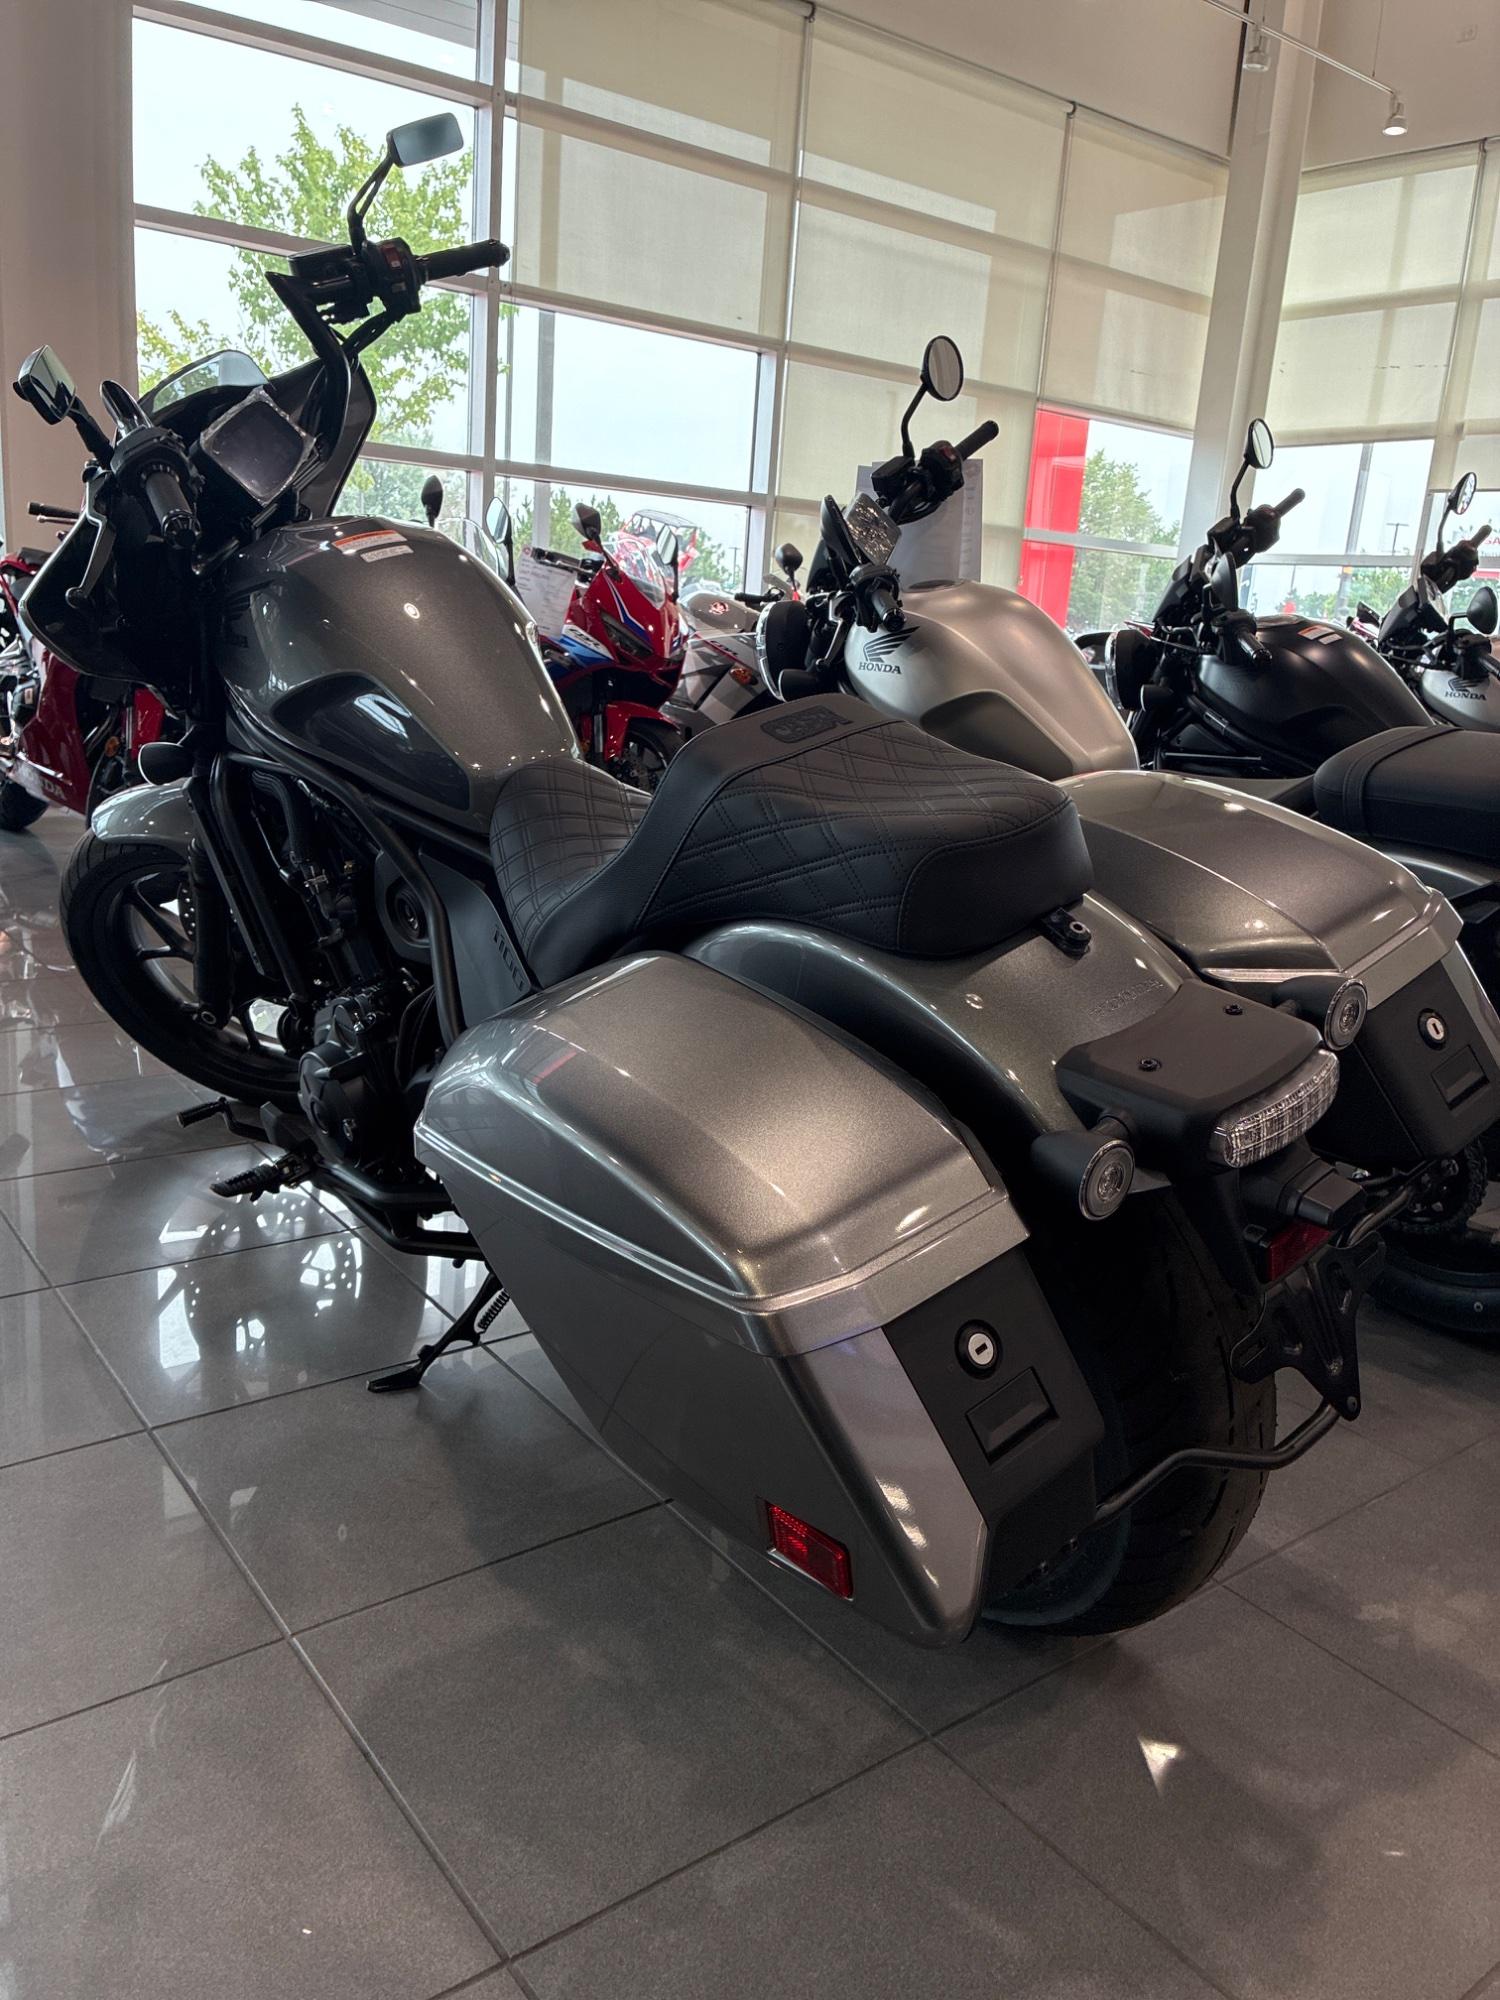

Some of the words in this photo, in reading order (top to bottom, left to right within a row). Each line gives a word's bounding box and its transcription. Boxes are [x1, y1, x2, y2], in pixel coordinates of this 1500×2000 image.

[858, 661, 902, 675] HONDA
[1444, 690, 1487, 702] HONDA
[493, 922, 525, 992] 1100
